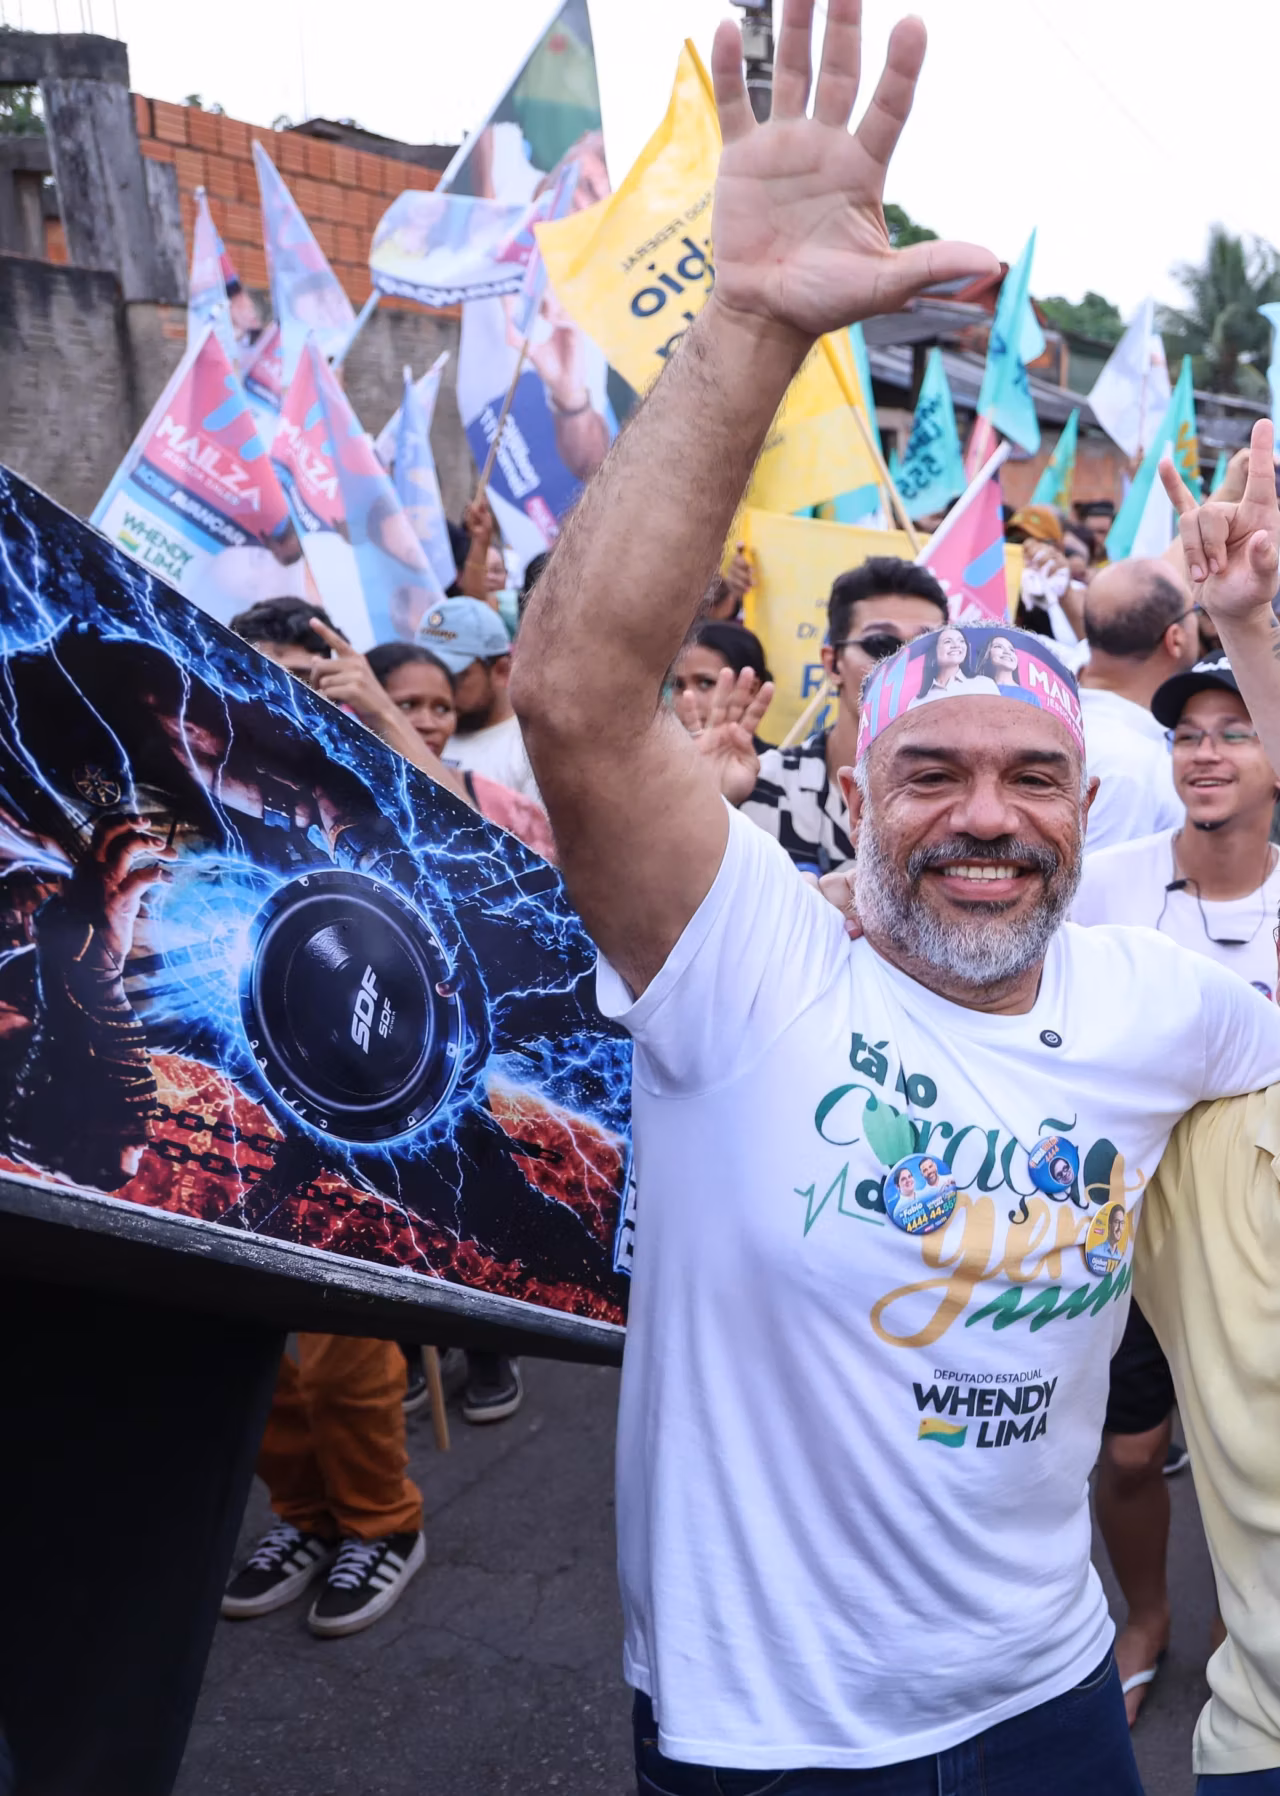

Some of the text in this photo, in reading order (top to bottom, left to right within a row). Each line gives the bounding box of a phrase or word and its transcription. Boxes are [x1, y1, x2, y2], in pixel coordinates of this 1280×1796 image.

[155, 415, 262, 512] MAILZA
[277, 416, 341, 501] MAILZA
[122, 511, 195, 563] WHENDY
[141, 544, 184, 582] LIMA
[350, 963, 379, 1055] SDF
[378, 996, 392, 1039] SDF
[849, 1032, 889, 1087] tá
[912, 1376, 1058, 1417] WHENDY
[933, 1368, 1043, 1384] DEPUTADO ESTADUAL
[976, 1411, 1047, 1448] LIMA
